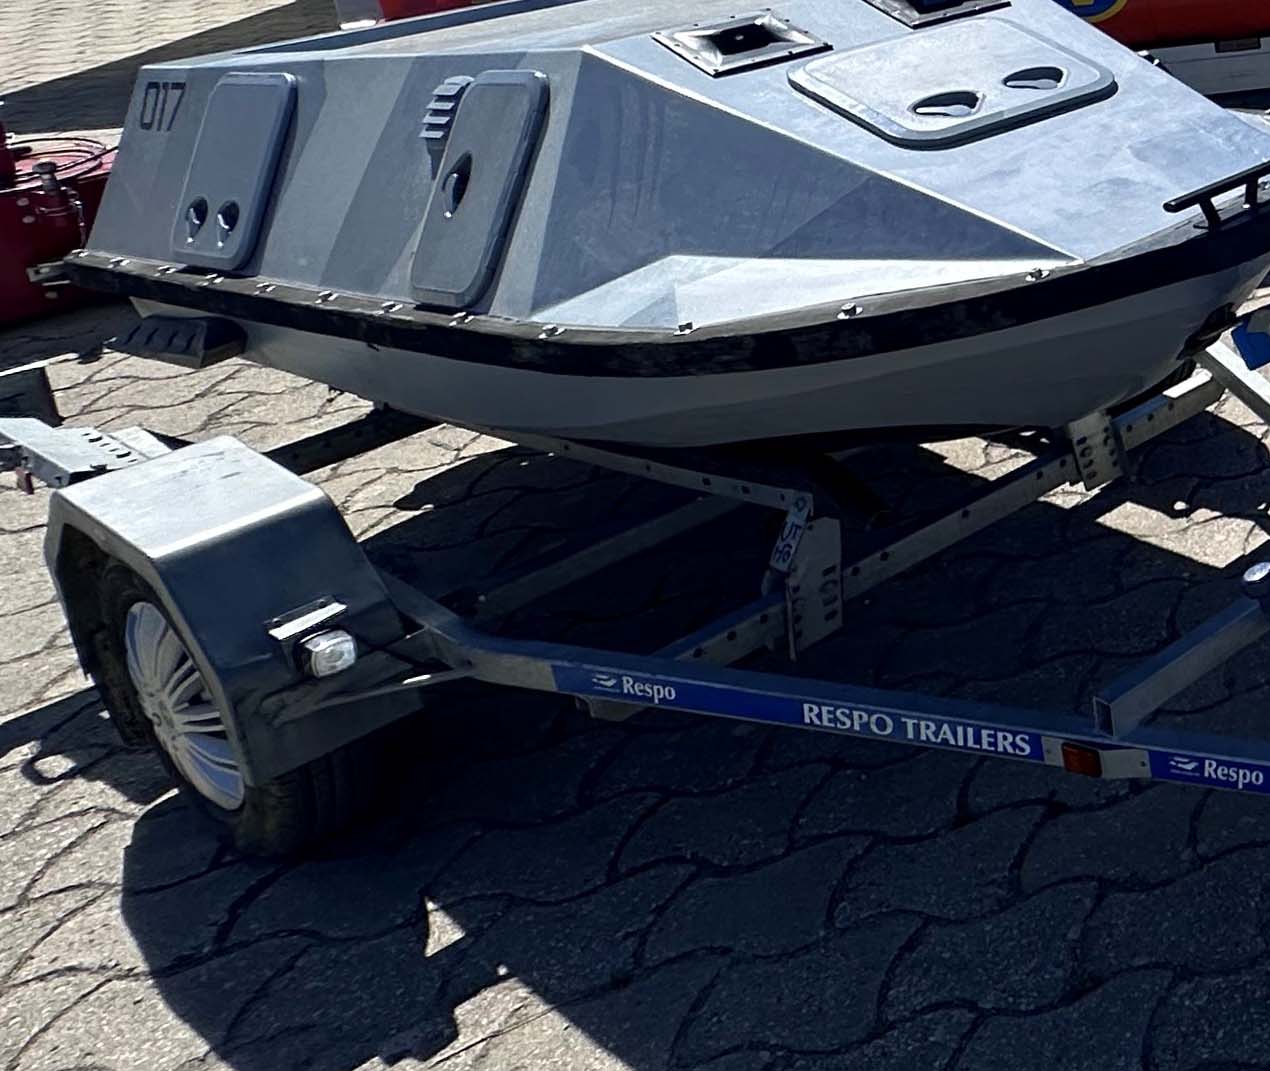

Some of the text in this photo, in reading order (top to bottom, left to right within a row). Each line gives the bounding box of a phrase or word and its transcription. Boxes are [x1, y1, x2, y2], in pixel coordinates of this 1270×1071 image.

[139, 81, 187, 132] 017
[621, 675, 677, 705] Respo
[802, 702, 1032, 757] RESPO TRAILERS
[1203, 758, 1265, 790] Respo
